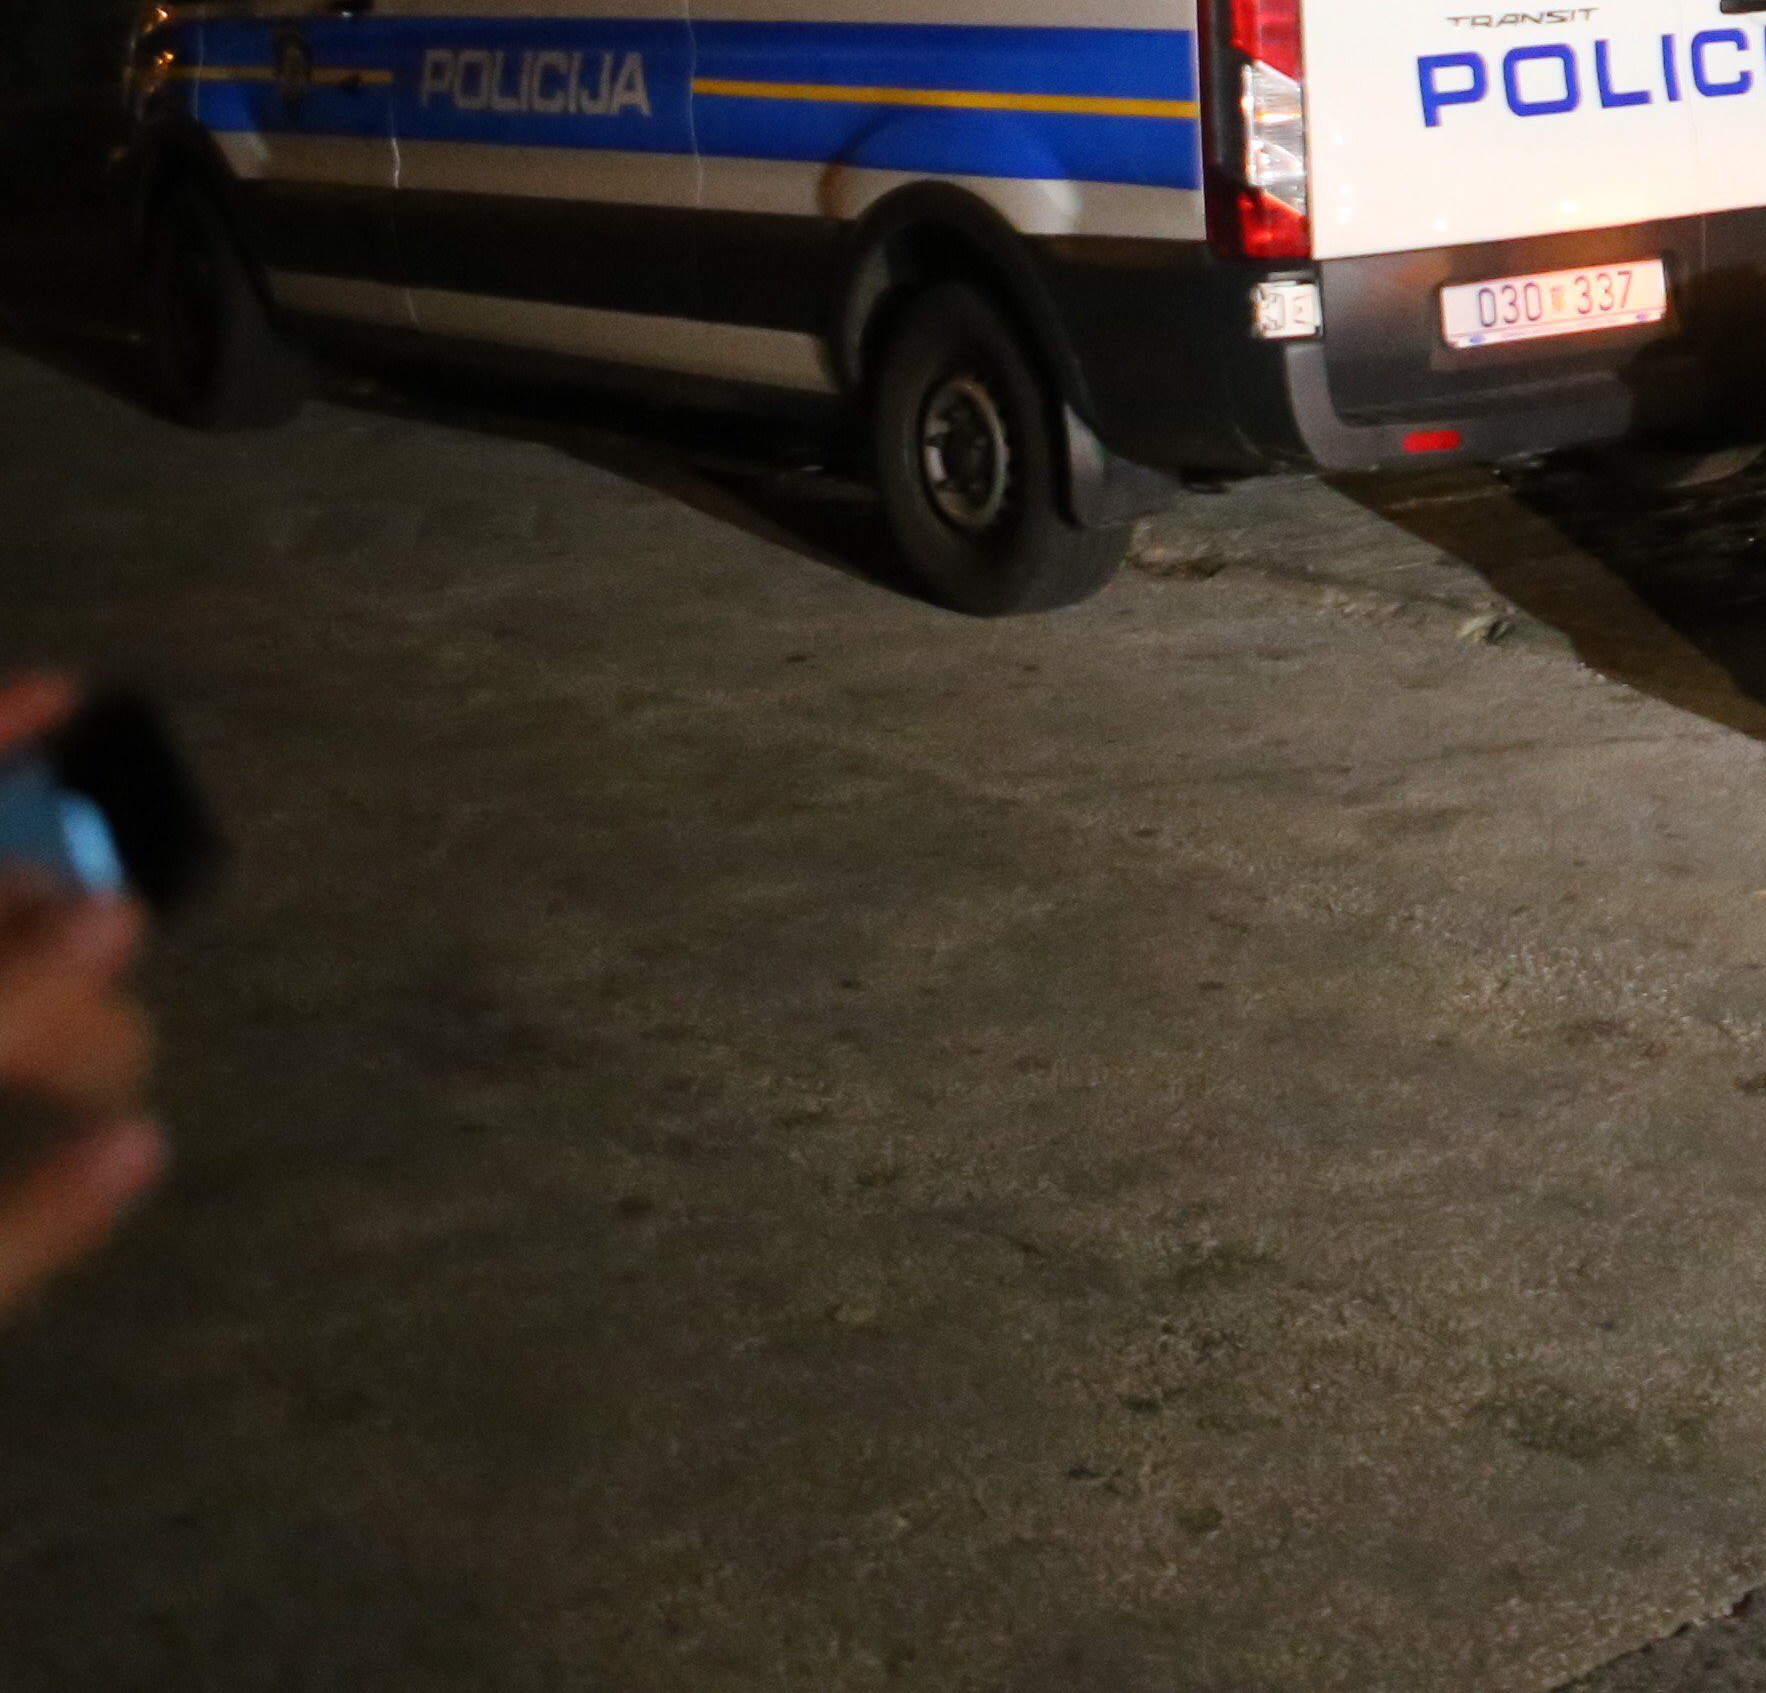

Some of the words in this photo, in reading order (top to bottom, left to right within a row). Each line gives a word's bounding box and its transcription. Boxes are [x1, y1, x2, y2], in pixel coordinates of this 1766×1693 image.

[1446, 7, 1600, 29] TRANSIT
[421, 48, 651, 116] POLICIJA
[1478, 279, 1544, 329] 030
[1574, 270, 1635, 316] 337
